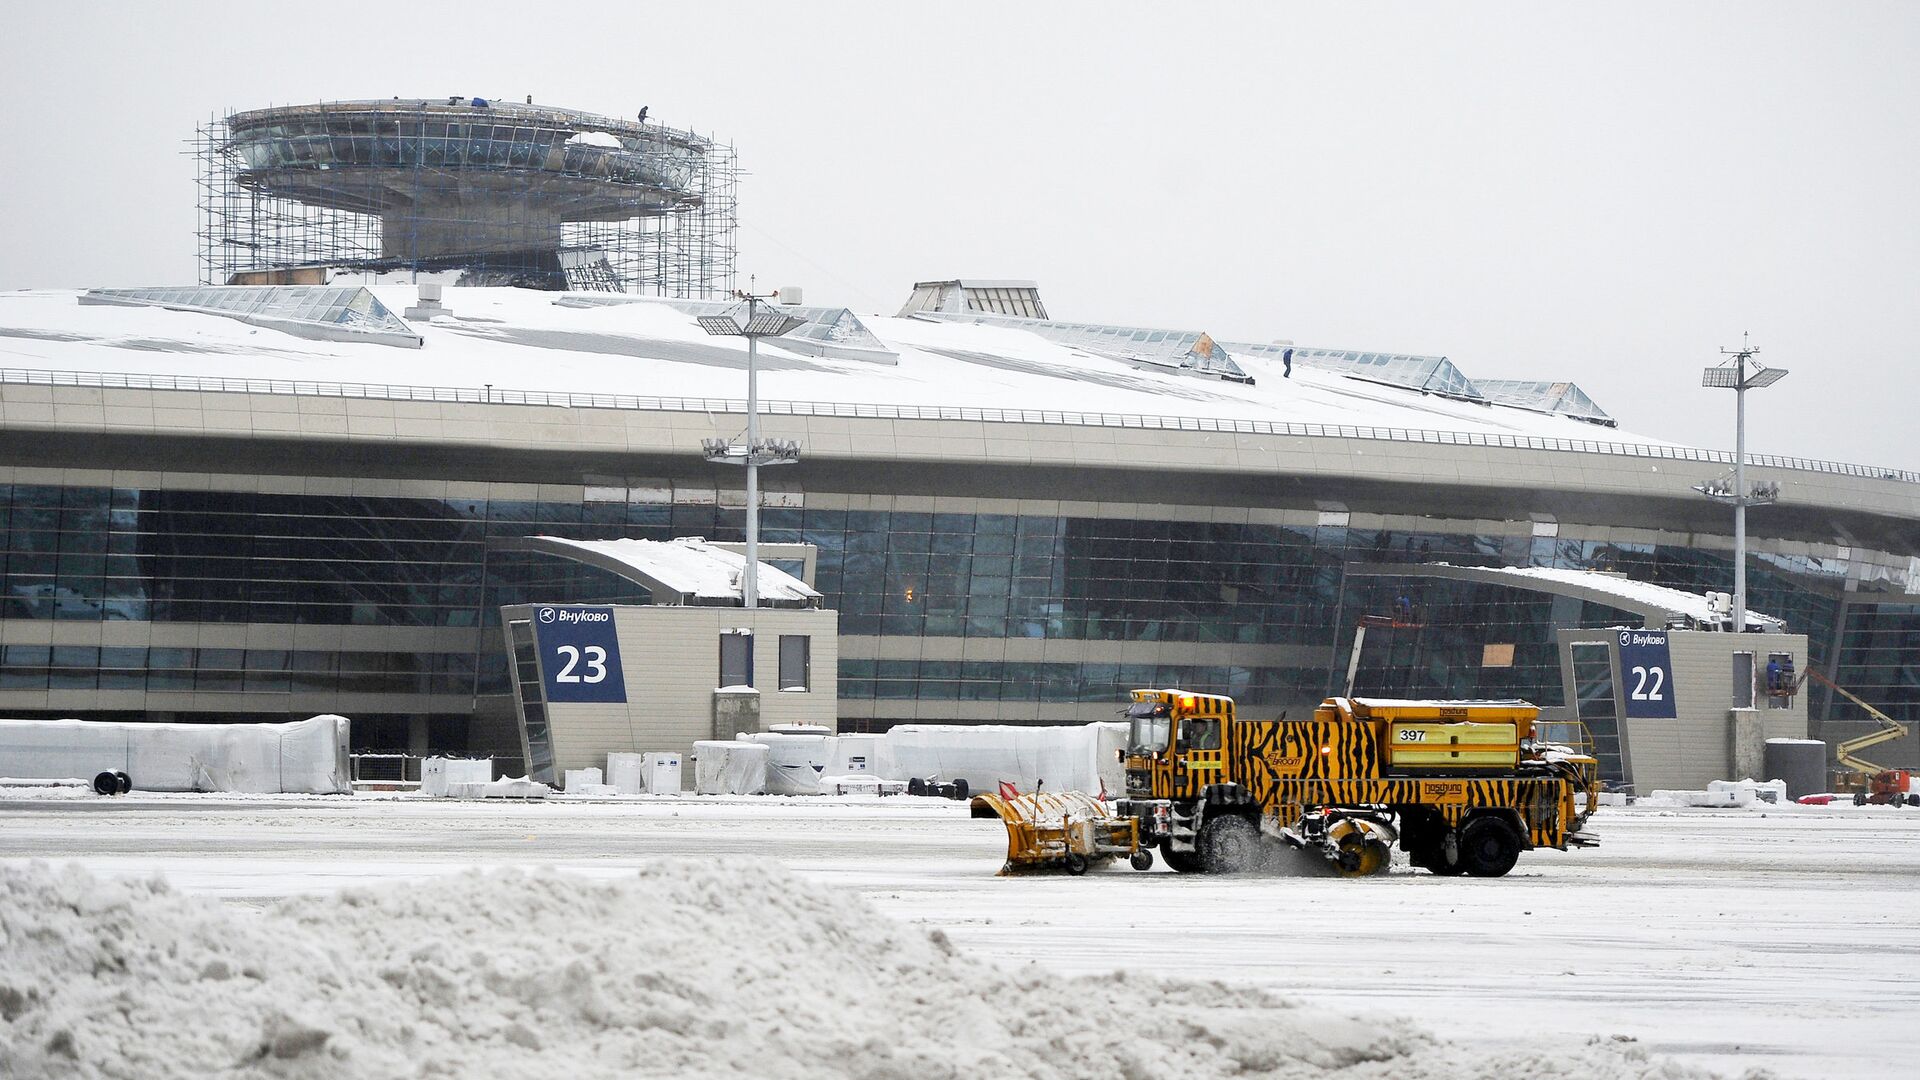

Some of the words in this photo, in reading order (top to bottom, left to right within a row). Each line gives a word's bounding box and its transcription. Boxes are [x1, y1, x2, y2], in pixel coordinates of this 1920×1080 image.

[559, 610, 608, 624] Внуково
[1633, 634, 1665, 647] Внуково
[556, 645, 607, 683] 23
[1632, 666, 1664, 700] 22
[1400, 730, 1425, 741] 397
